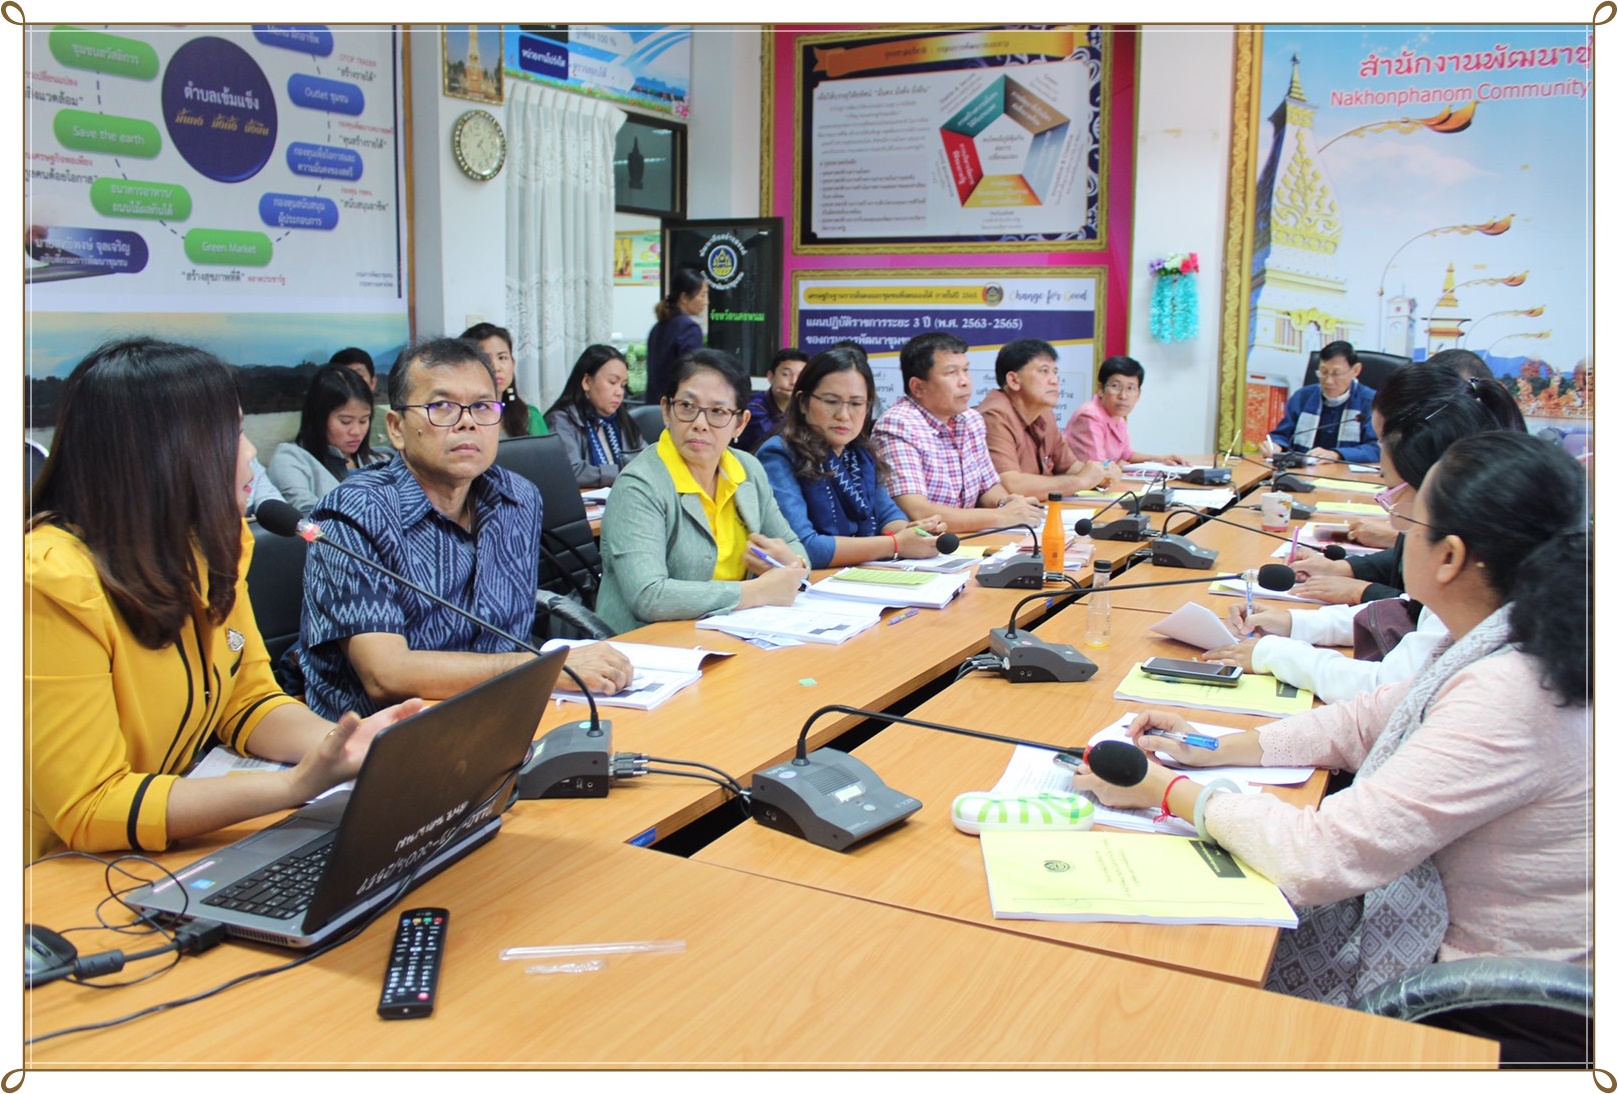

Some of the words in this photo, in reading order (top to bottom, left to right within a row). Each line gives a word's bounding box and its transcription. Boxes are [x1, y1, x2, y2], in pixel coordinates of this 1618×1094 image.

[184, 80, 259, 110] ตำบลเข้มแข็ง
[1330, 86, 1473, 108] Nakhonphanom
[1477, 78, 1592, 102] Community
[73, 125, 97, 138] Save
[100, 128, 117, 141] the
[120, 131, 145, 145] earth
[202, 241, 227, 252] Green
[1009, 288, 1043, 304] Change
[913, 317, 920, 328] 3
[922, 315, 931, 328] ปี
